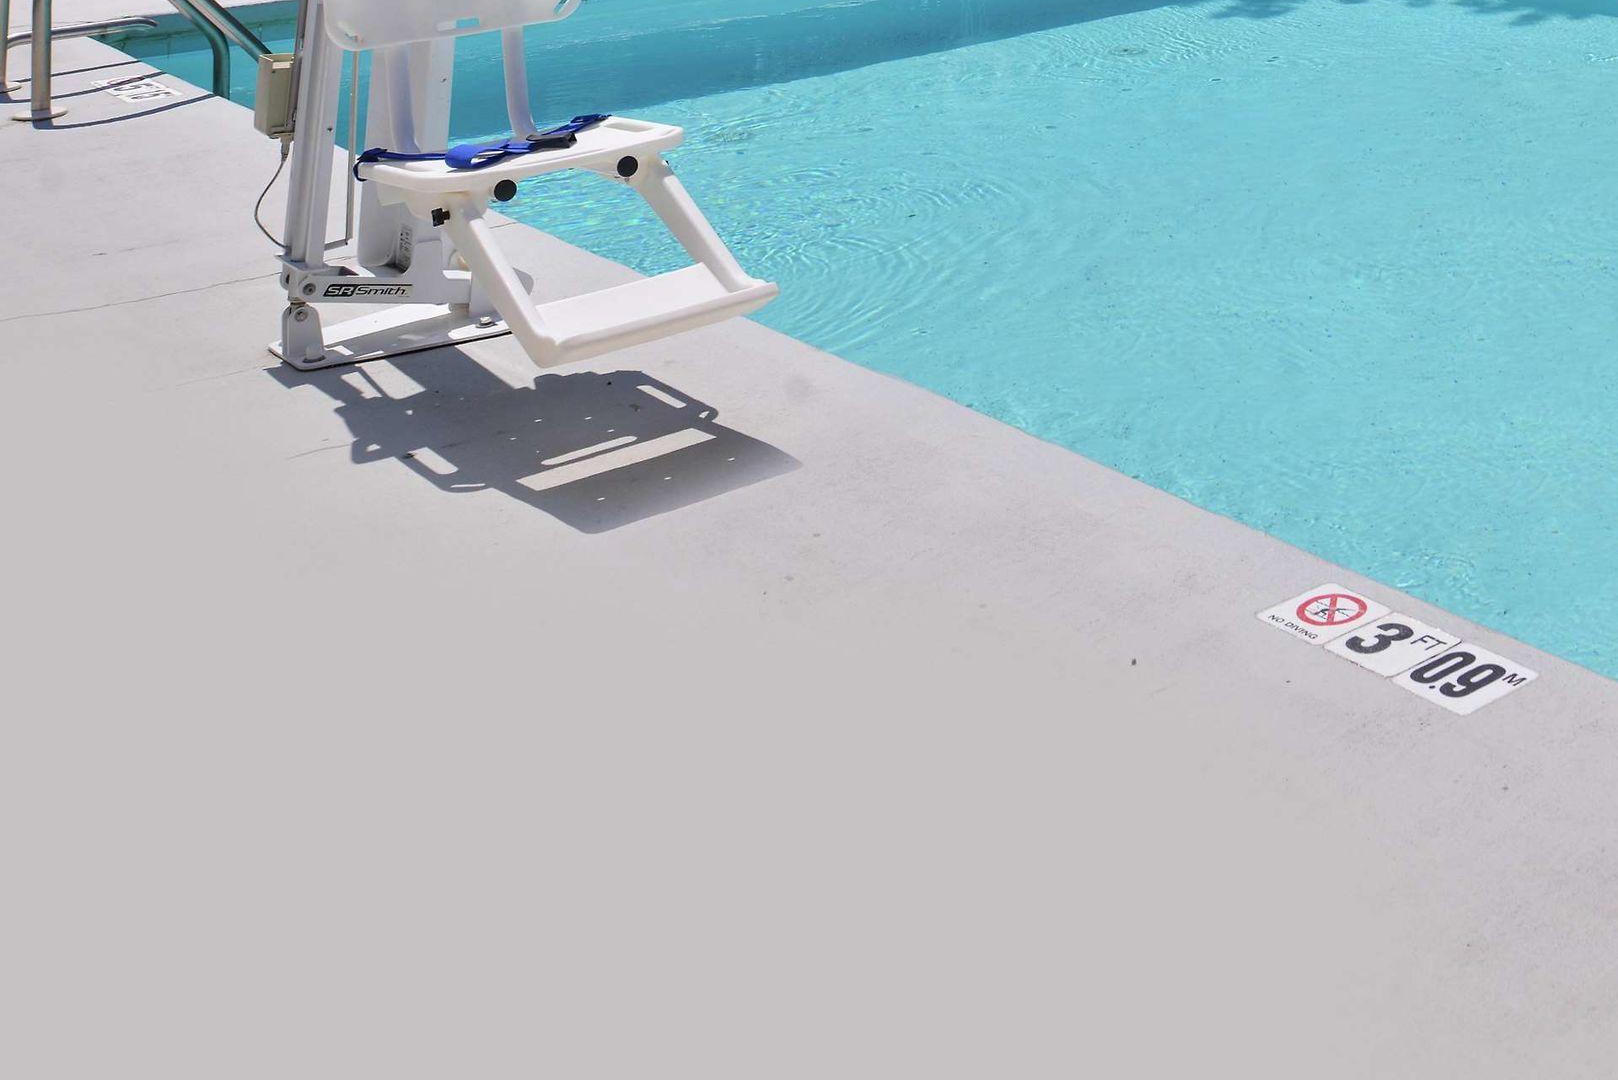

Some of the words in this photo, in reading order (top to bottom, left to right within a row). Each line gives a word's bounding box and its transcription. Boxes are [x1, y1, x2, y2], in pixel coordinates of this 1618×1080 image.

[355, 286, 407, 296] Smith
[1267, 614, 1285, 623] NO
[1284, 621, 1319, 640] DIVING
[1345, 622, 1414, 654] 3
[1410, 634, 1447, 651] FT
[1410, 651, 1506, 698] 0.9
[1502, 672, 1527, 687] M
